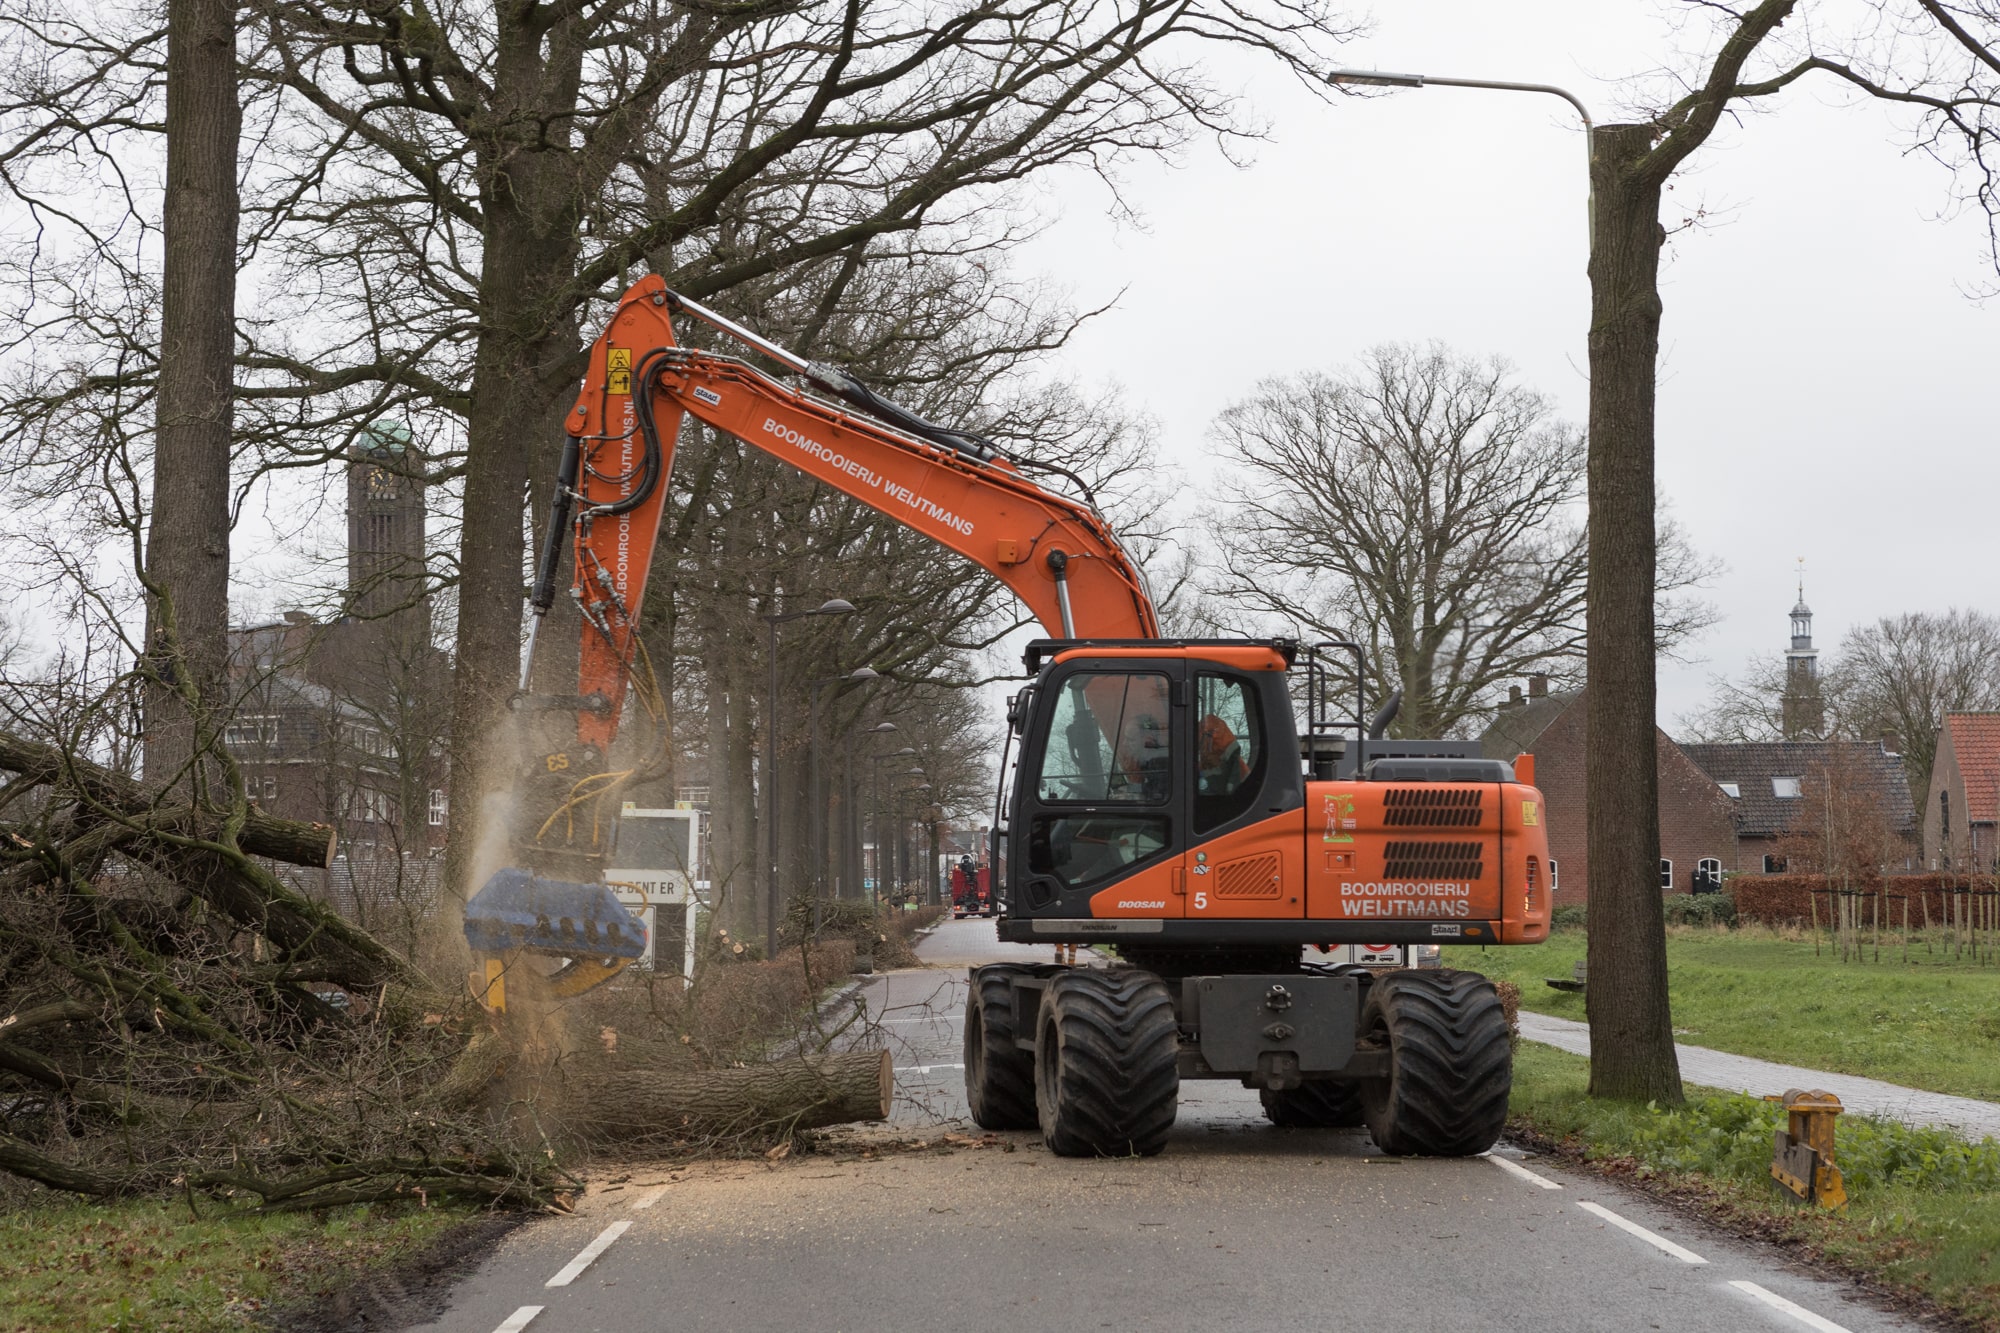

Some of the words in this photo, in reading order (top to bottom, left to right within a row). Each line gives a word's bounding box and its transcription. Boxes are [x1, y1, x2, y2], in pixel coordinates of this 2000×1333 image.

[695, 387, 718, 402] staad
[762, 418, 884, 488] BOOMROOIERIJ
[884, 479, 975, 536] WEIJTMANS
[660, 882, 674, 894] ER
[1340, 882, 1470, 896] BOOMROOIERIJ
[1117, 901, 1166, 909] DOOSAN
[1194, 892, 1207, 909] 5
[1341, 899, 1470, 917] WEIJTMANS
